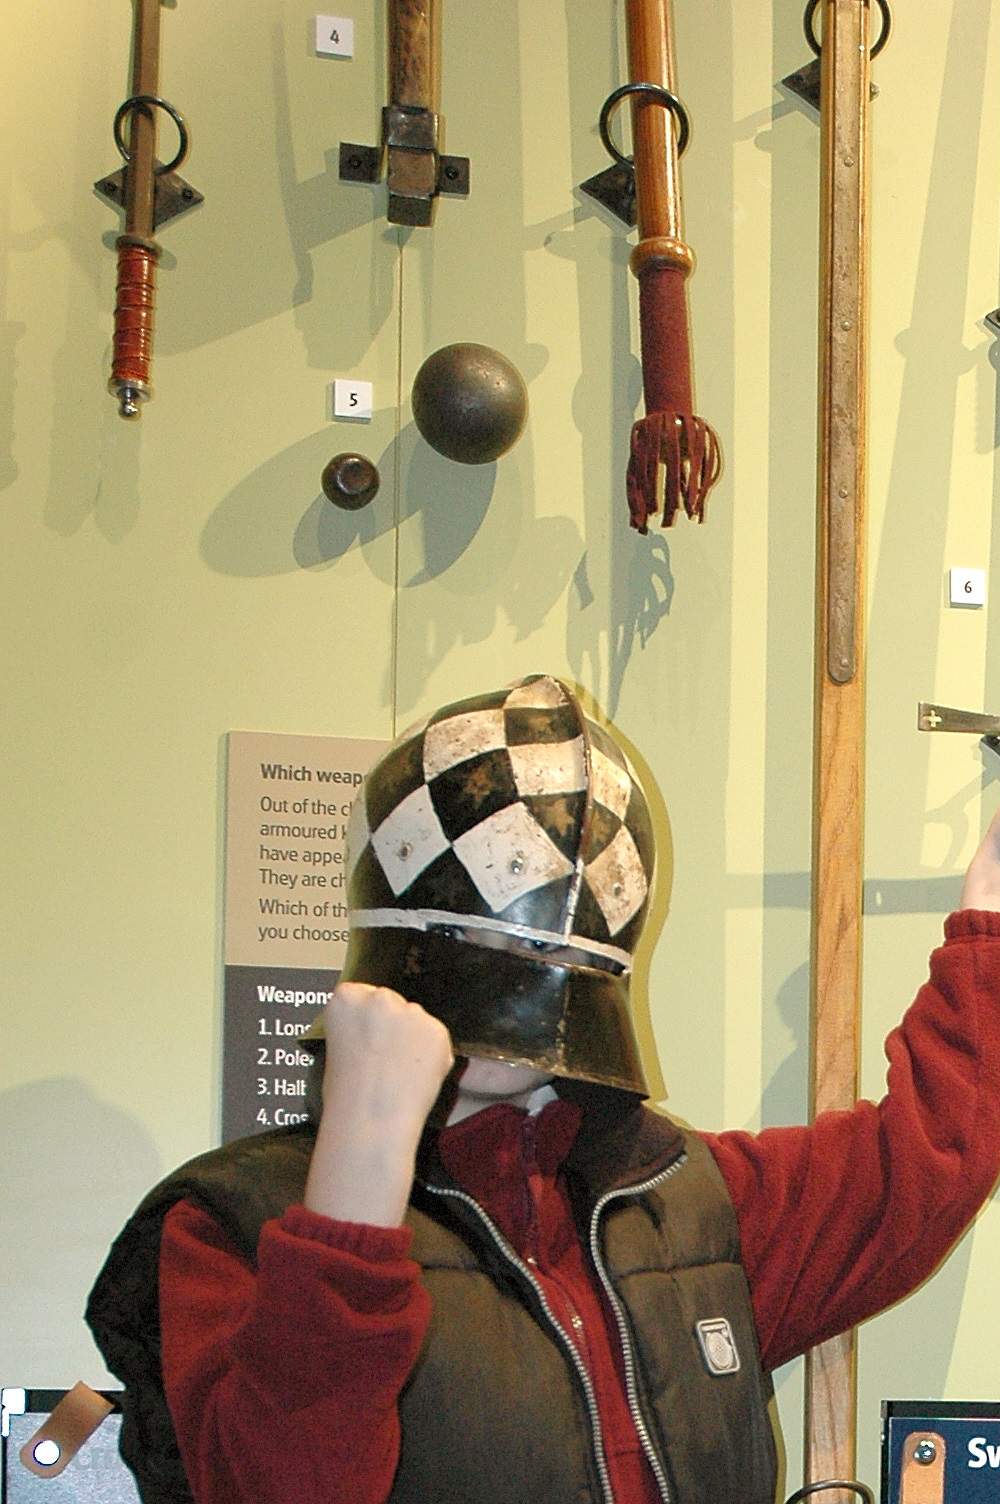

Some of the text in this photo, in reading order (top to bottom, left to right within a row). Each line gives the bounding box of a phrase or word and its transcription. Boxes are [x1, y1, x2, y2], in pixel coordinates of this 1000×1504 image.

[330, 29, 340, 44] 4
[349, 392, 358, 407] 5
[964, 580, 972, 594] 6
[260, 763, 312, 782] Which
[260, 796, 289, 813] Out
[292, 798, 310, 814] of
[311, 799, 337, 817] the
[259, 824, 337, 840] armoured
[259, 844, 349, 867] have appe
[258, 867, 298, 890] They
[301, 874, 327, 888] are
[258, 897, 308, 916] Which
[313, 901, 330, 917] of
[257, 926, 289, 942] you
[258, 1018, 273, 1036] 1.
[257, 1047, 273, 1066] 2.
[257, 1077, 271, 1096] 3.
[256, 1107, 271, 1126] 4.
